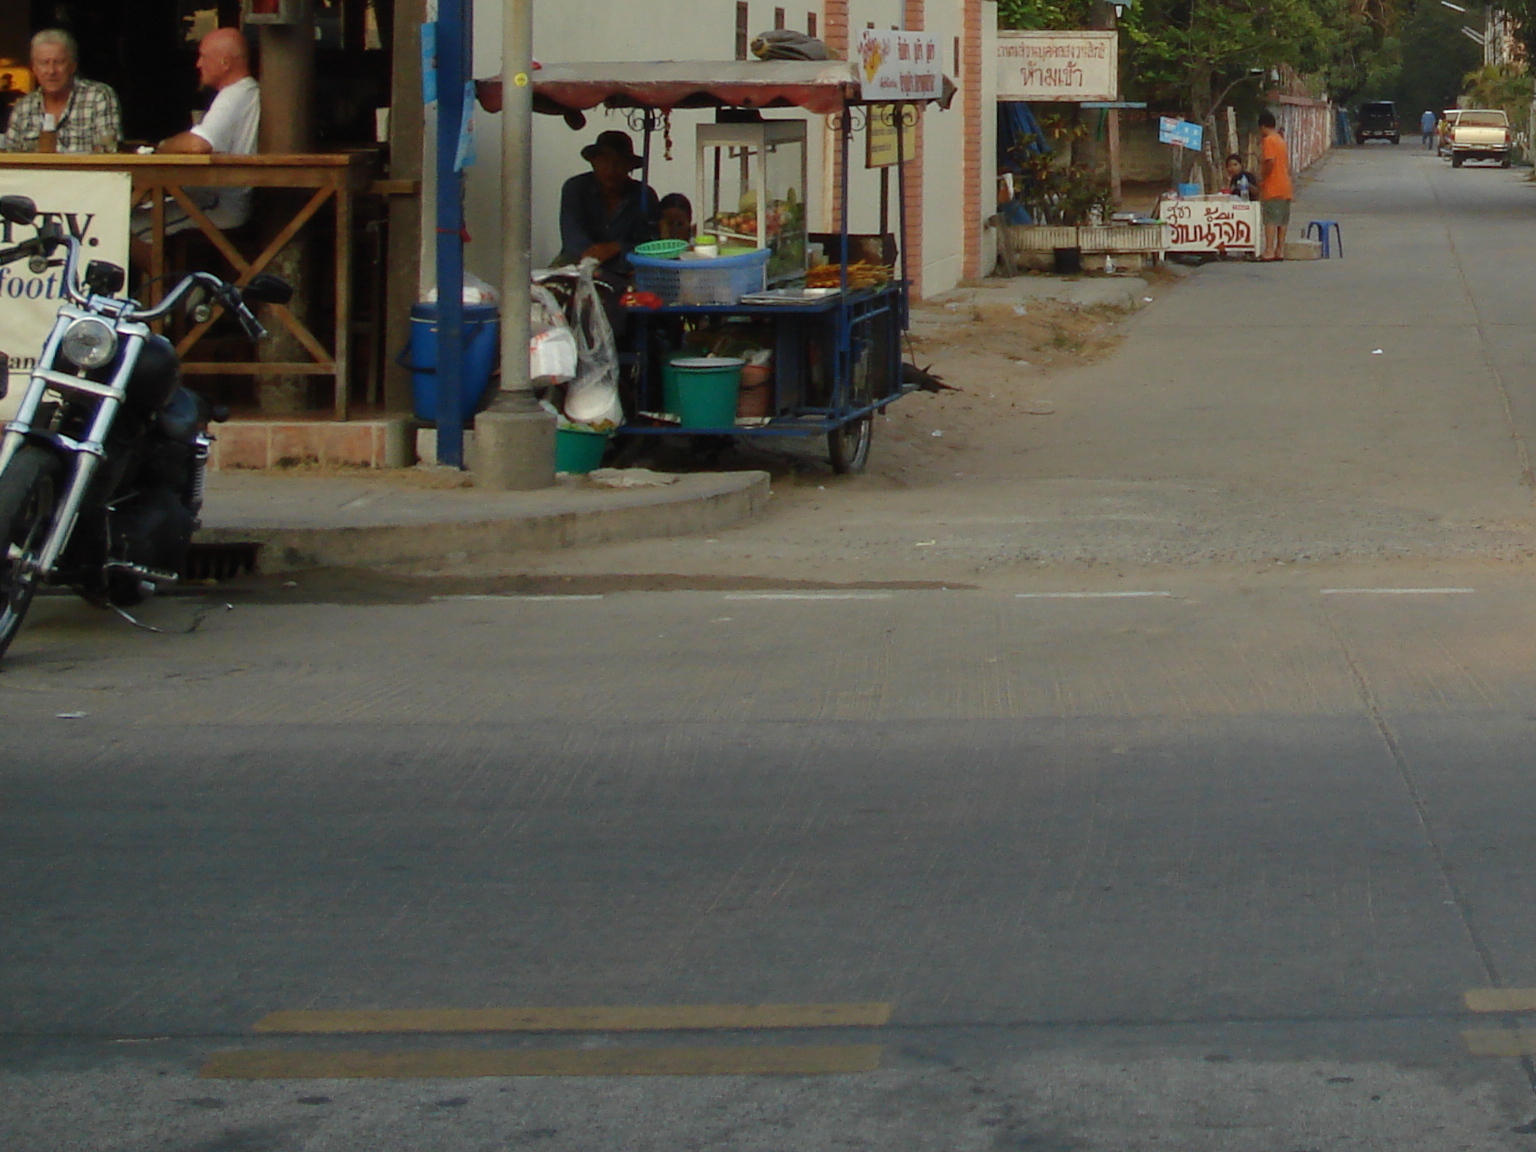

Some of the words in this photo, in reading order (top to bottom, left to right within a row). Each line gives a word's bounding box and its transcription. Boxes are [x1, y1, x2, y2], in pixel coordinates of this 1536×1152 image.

[1020, 60, 1083, 87] ห้ามเข้า
[1167, 203, 1191, 224] สุขา
